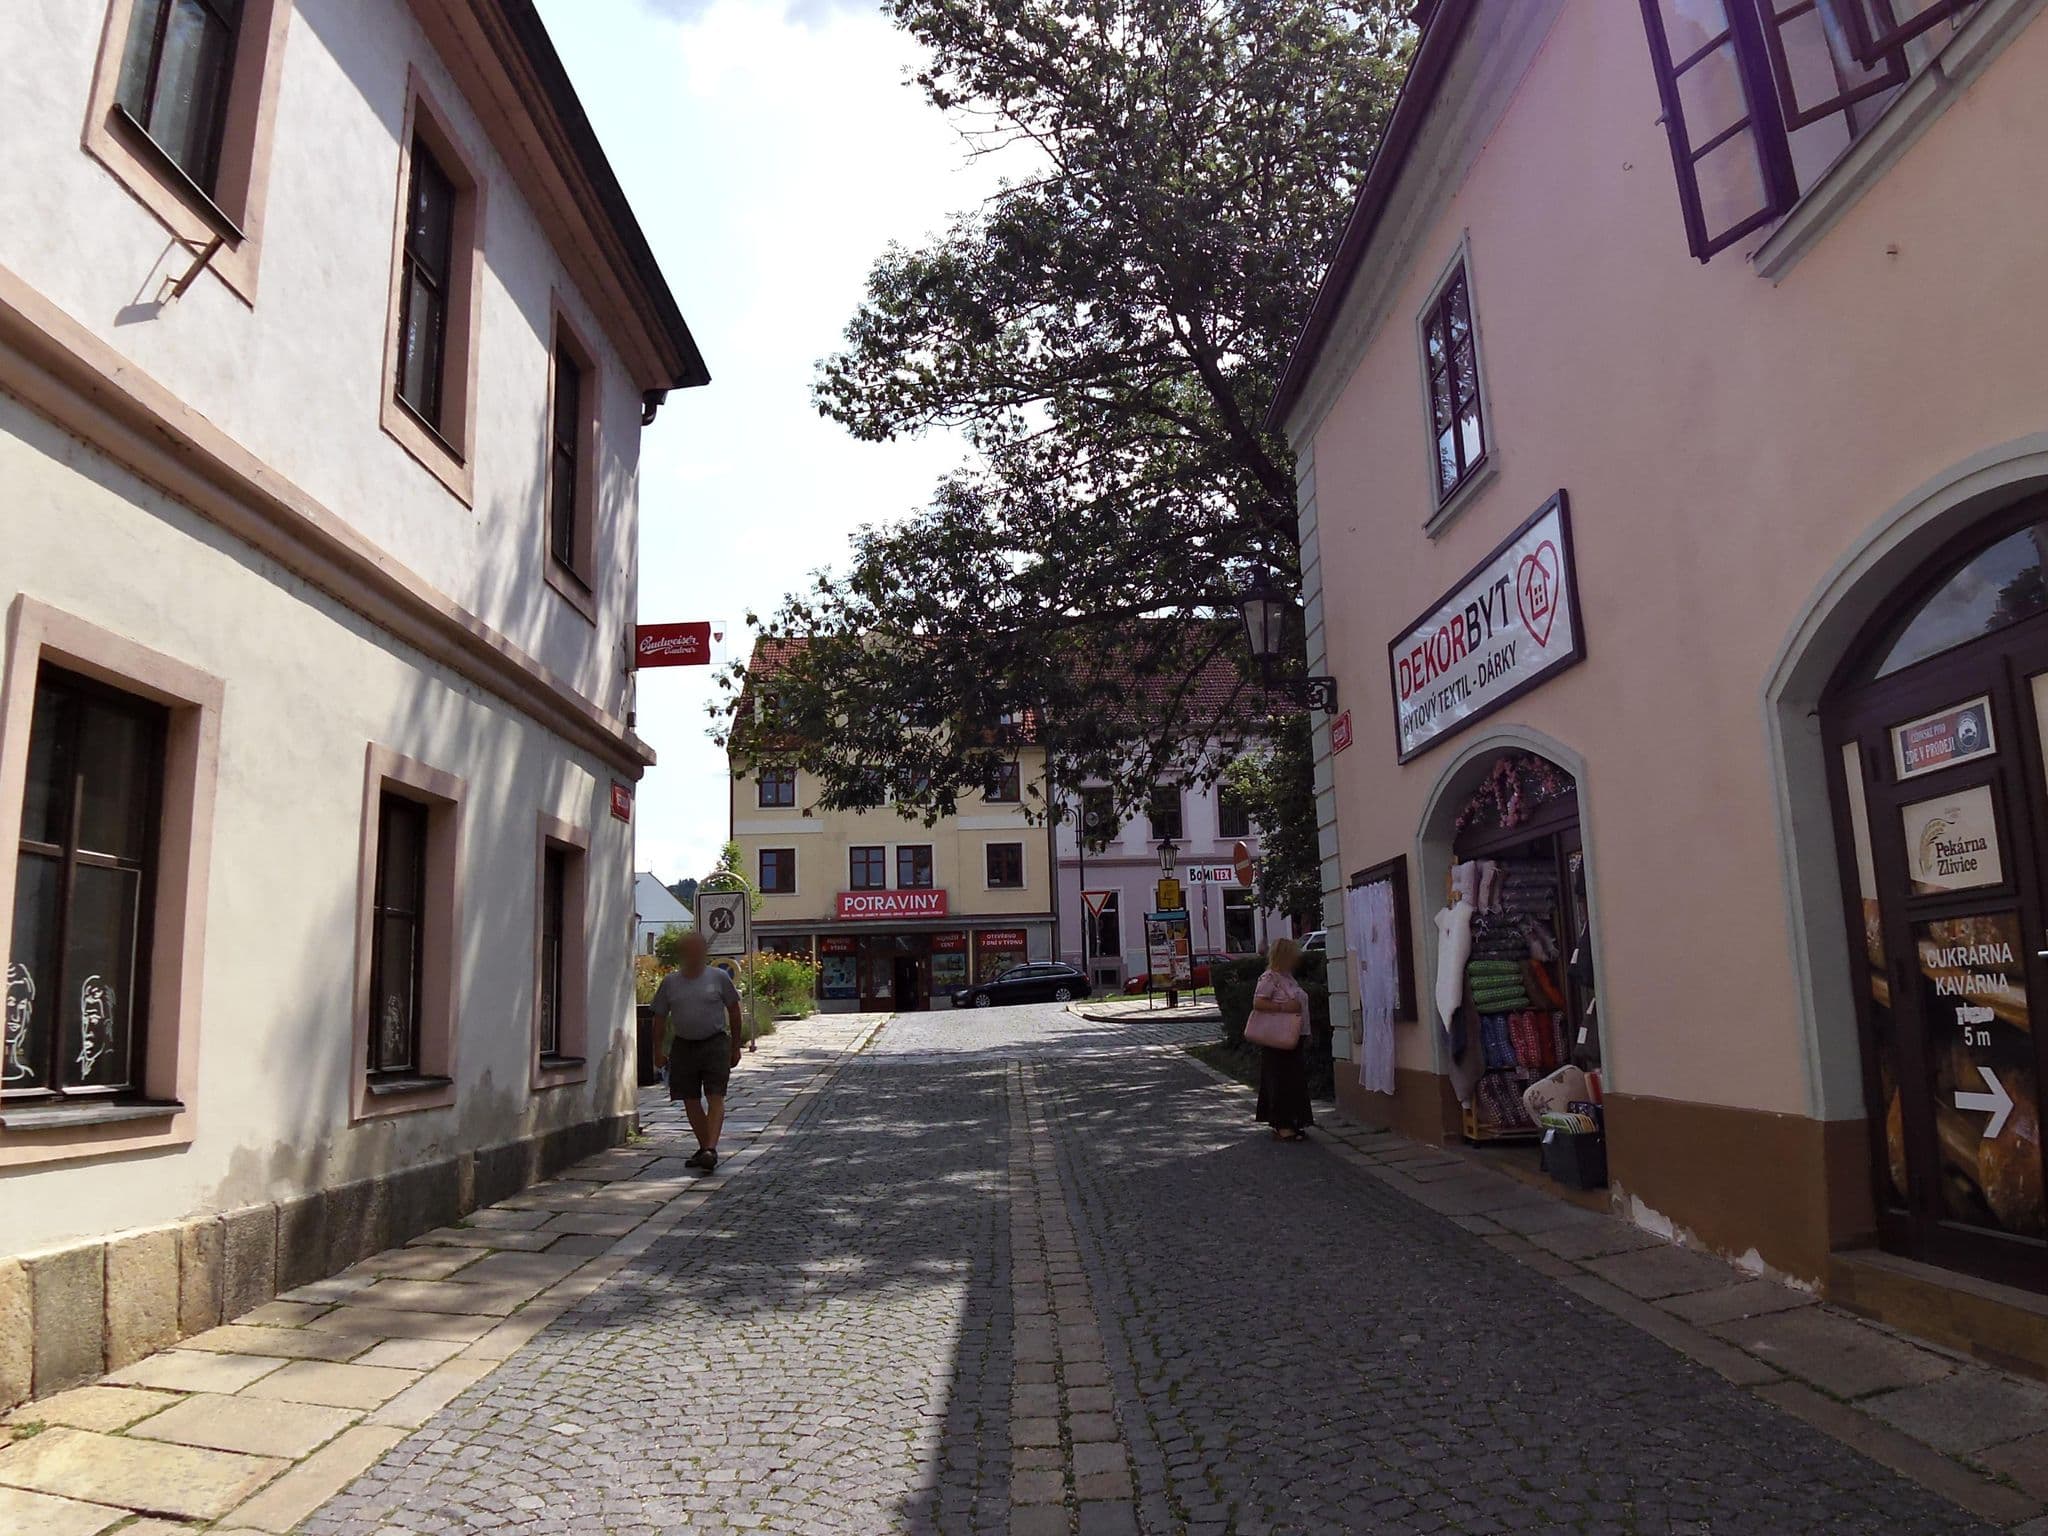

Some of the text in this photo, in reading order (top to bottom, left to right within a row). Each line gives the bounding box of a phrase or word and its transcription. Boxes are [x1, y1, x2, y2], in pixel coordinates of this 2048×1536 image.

[640, 634, 699, 655] Budweiser
[1399, 574, 1510, 701] DEKORBYT
[1403, 691, 1437, 737] BYTOVÝ
[1438, 674, 1472, 713] TEXTIL
[1478, 640, 1516, 688] DÁRKY
[1935, 836, 1988, 858] Pekárna
[1937, 857, 1978, 876] Zlivice
[844, 894, 939, 911] POTRAVINY
[1927, 937, 2014, 968] CUKRÁRNA
[1935, 970, 2010, 996] KAVÁRNA
[1964, 1026, 1991, 1046] 5 m
